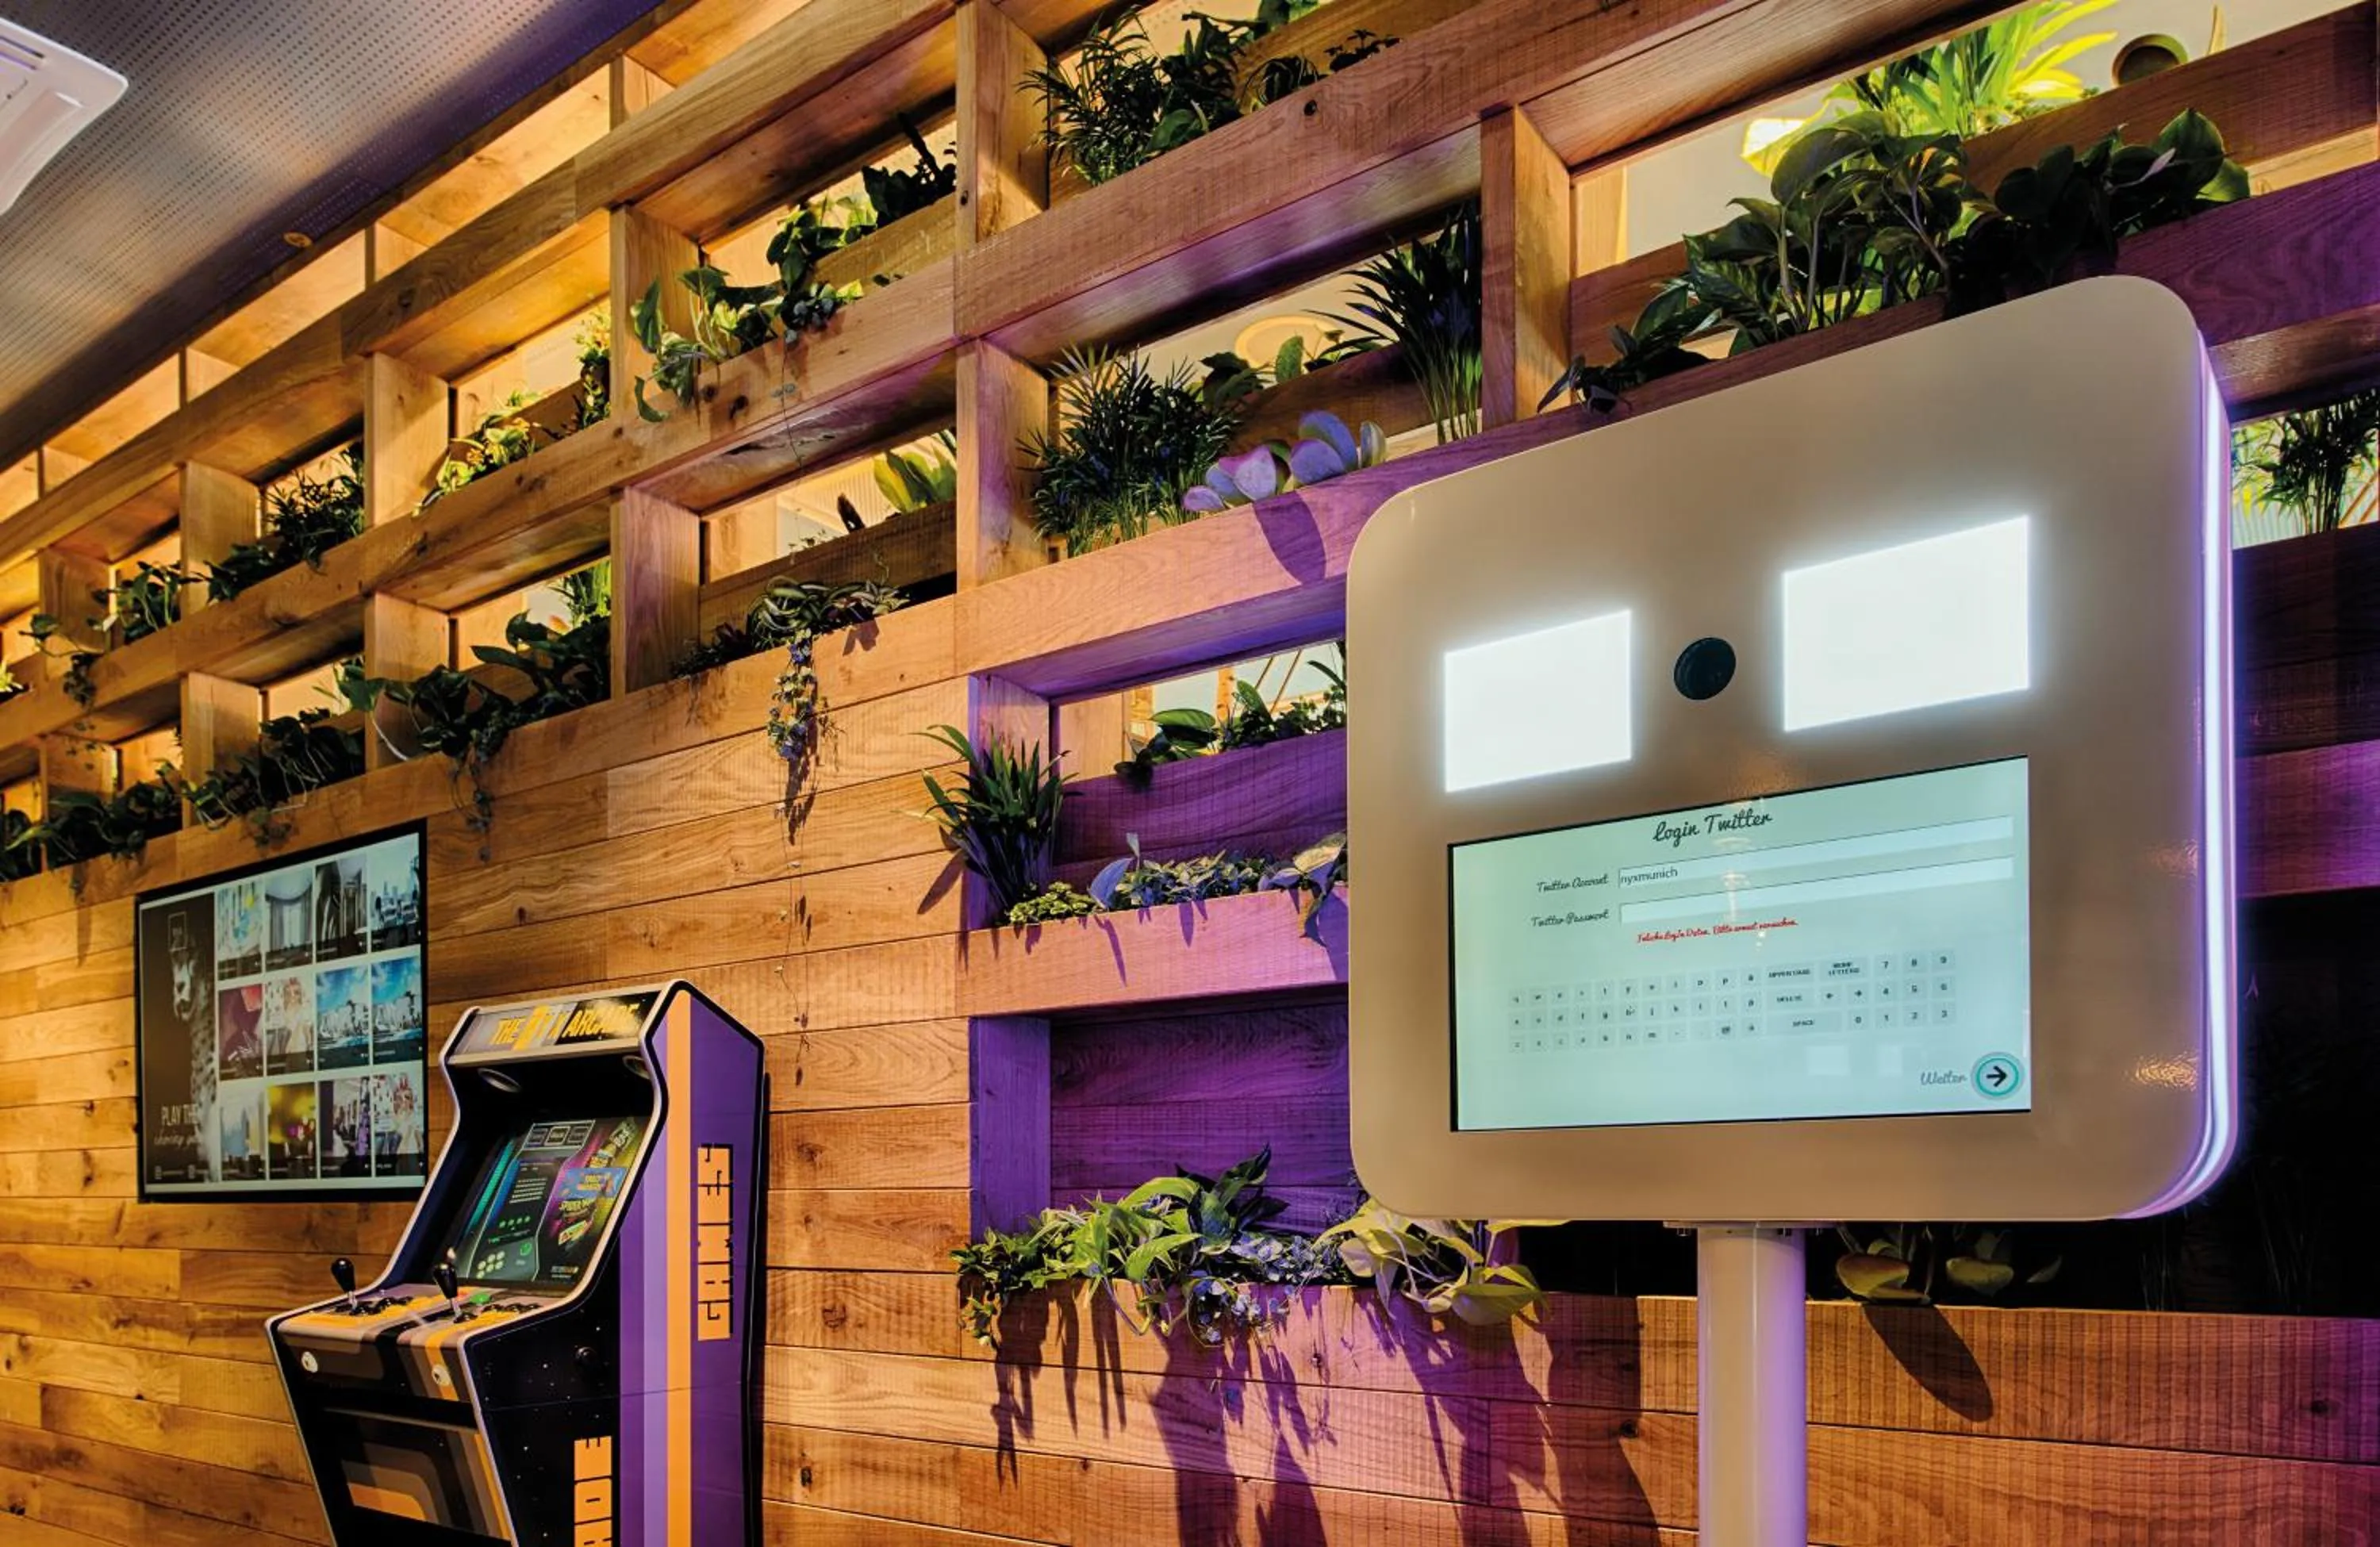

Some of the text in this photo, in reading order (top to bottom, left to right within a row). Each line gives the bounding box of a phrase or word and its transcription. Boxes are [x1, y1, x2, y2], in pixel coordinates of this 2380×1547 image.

[1653, 808, 1773, 847] Login Twitter
[1536, 873, 1609, 892] Twitter Account
[1620, 868, 1679, 887] nyxmunich
[1531, 915, 1564, 927] Twitter
[490, 1017, 525, 1046] THE
[1920, 1070, 1967, 1086] Weiter
[698, 1144, 732, 1341] GAMES
